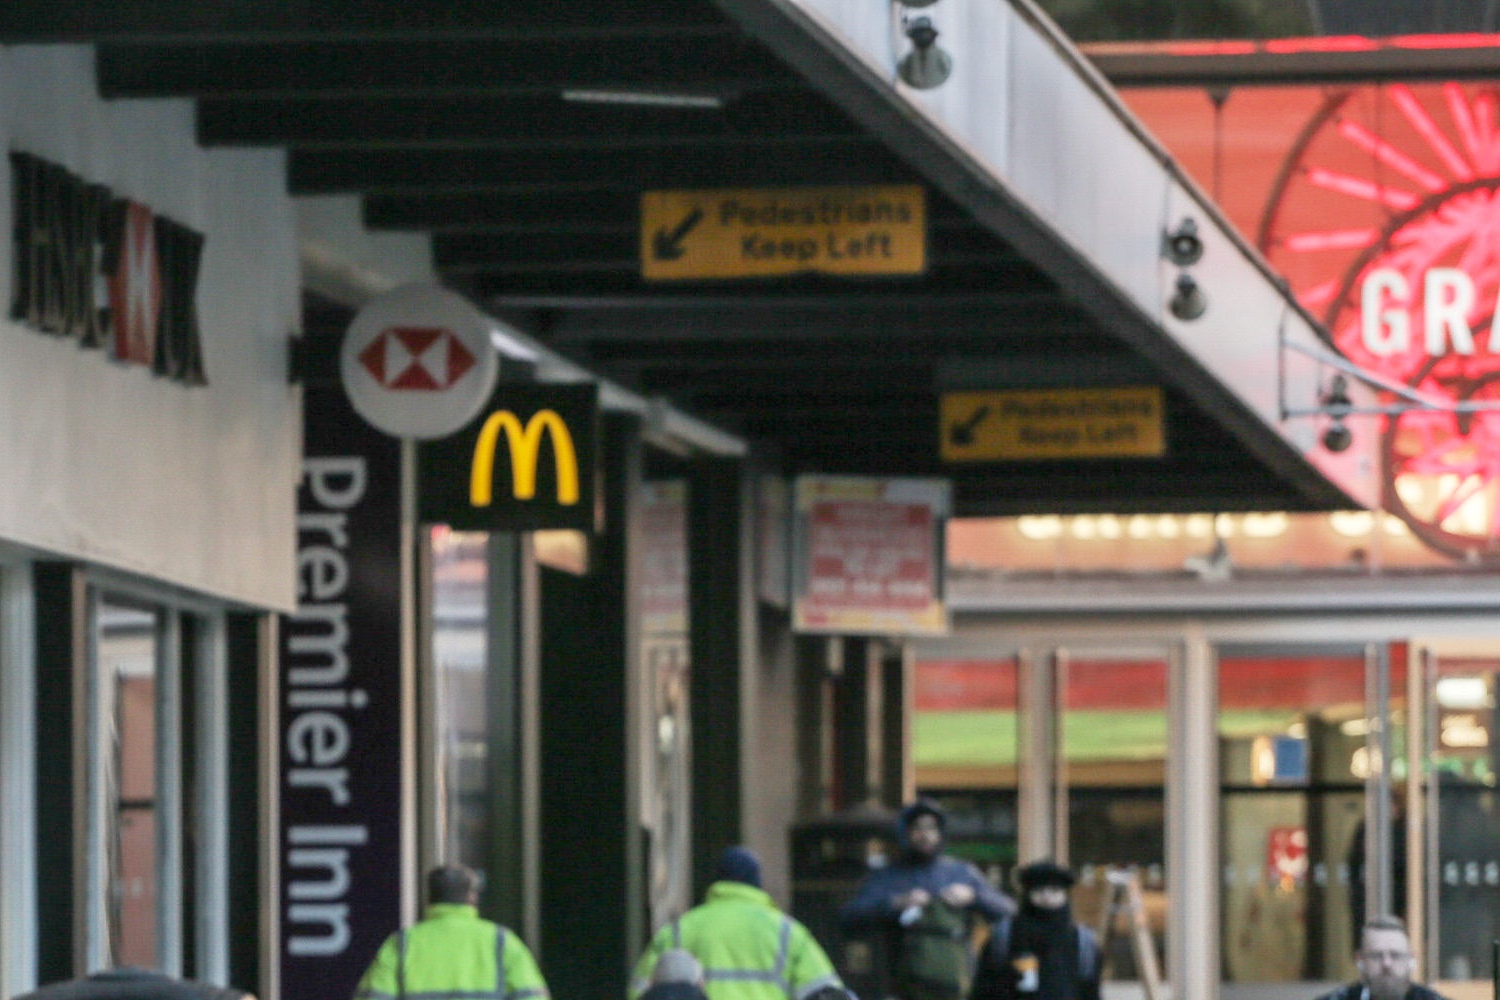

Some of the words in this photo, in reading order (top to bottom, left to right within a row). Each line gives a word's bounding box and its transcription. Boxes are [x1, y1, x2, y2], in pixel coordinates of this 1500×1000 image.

[719, 201, 912, 227] Pedestrians
[741, 232, 819, 261] Keep
[827, 232, 892, 259] Left
[1361, 266, 1500, 357] GR
[288, 456, 368, 806] Premier
[288, 825, 368, 956] Inn
